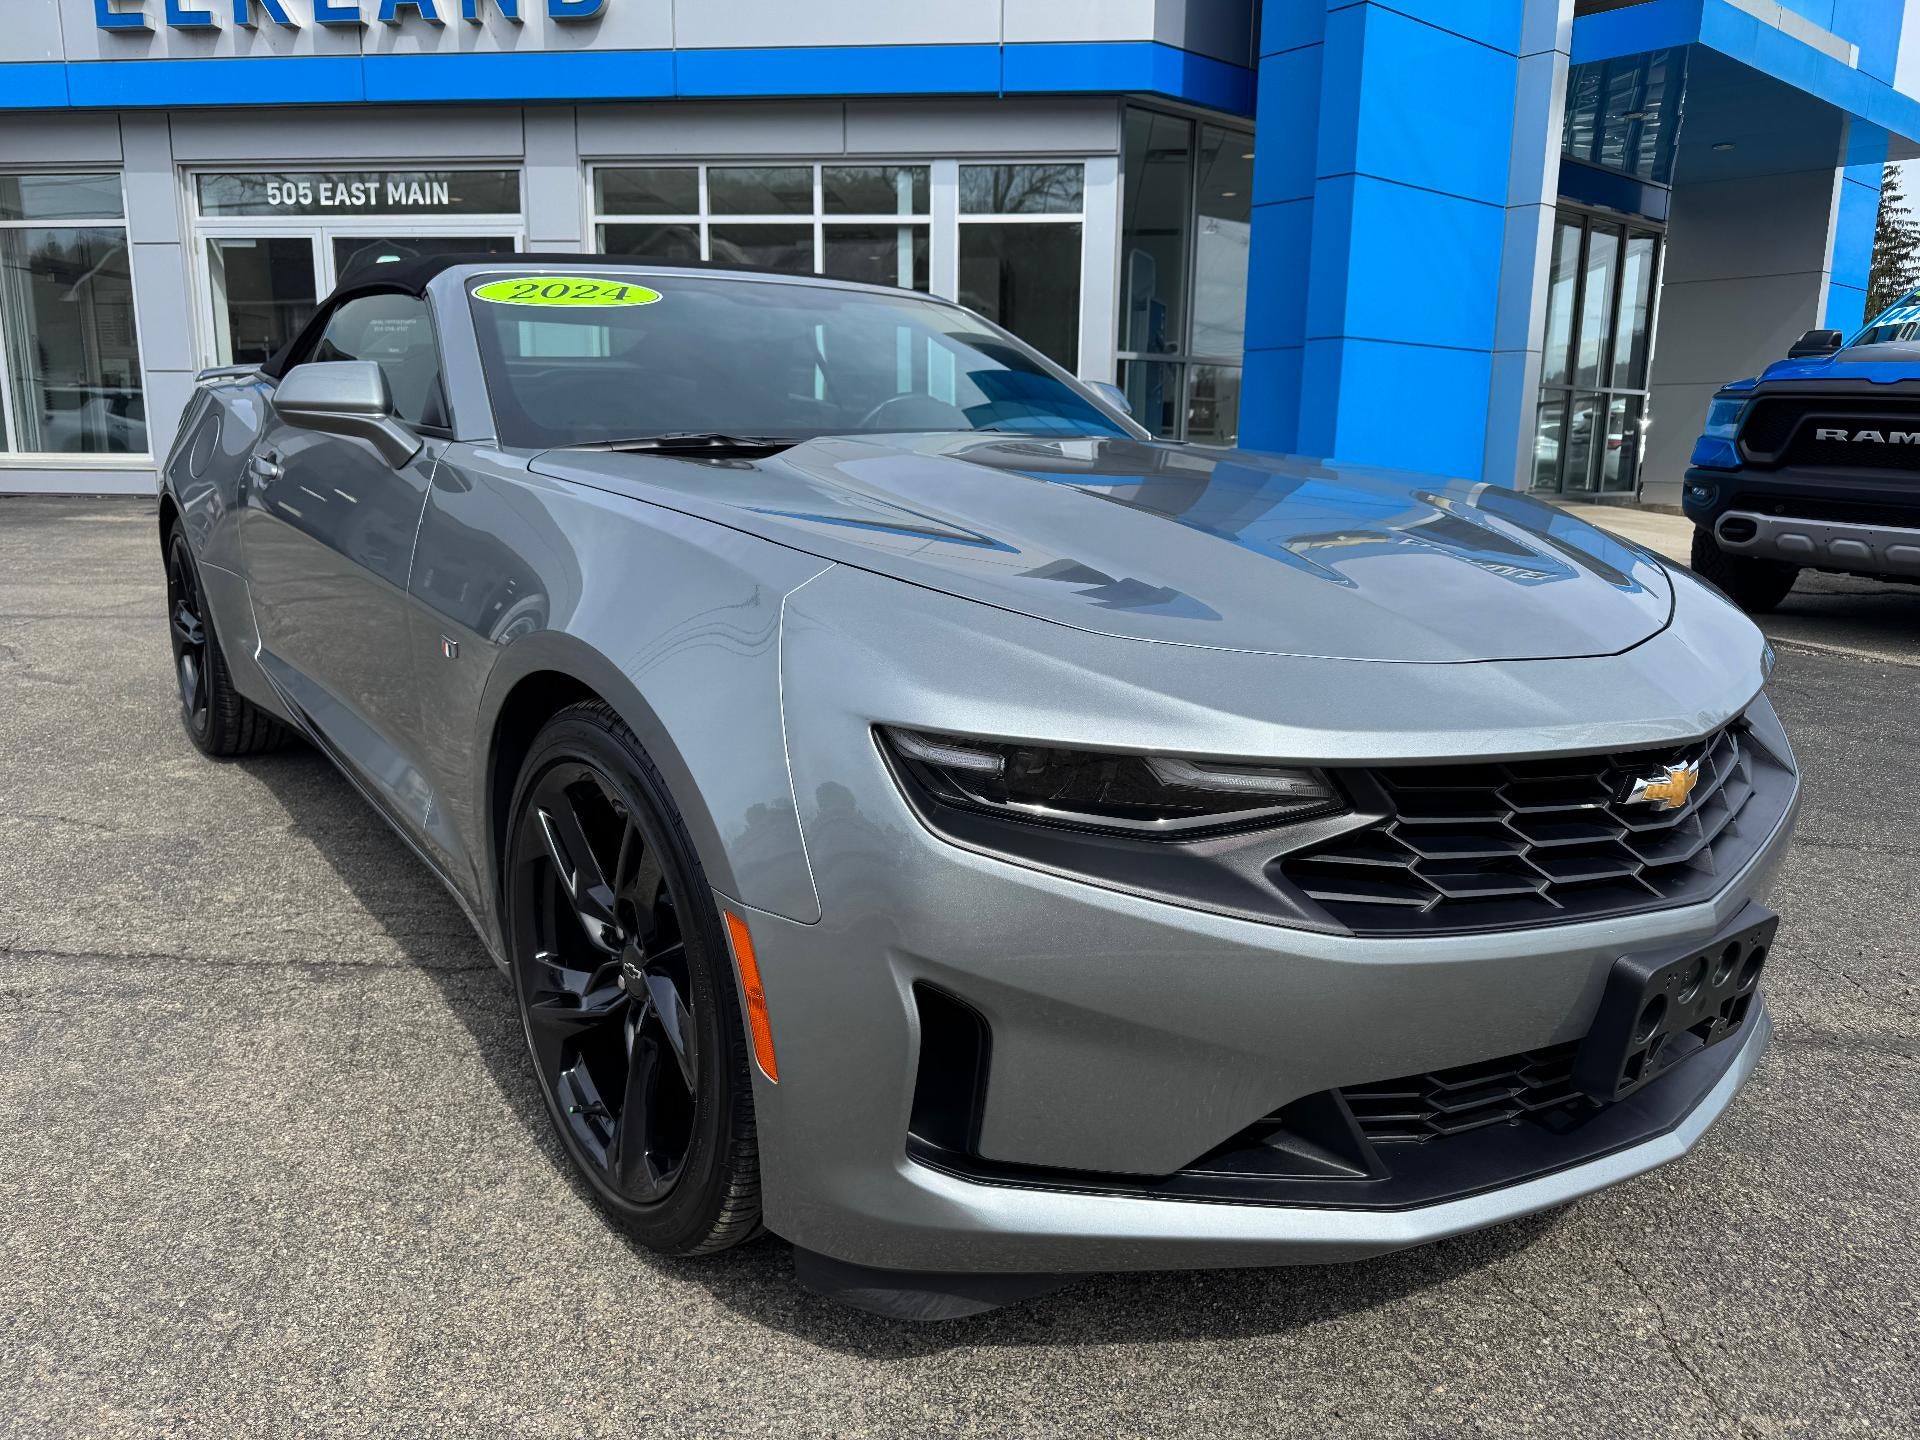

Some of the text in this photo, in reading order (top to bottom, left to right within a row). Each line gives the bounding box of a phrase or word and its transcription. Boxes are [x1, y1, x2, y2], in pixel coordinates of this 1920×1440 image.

[266, 181, 449, 206] 505 EAST MAIN
[507, 283, 632, 301] 2024
[1816, 428, 1920, 445] RAM
